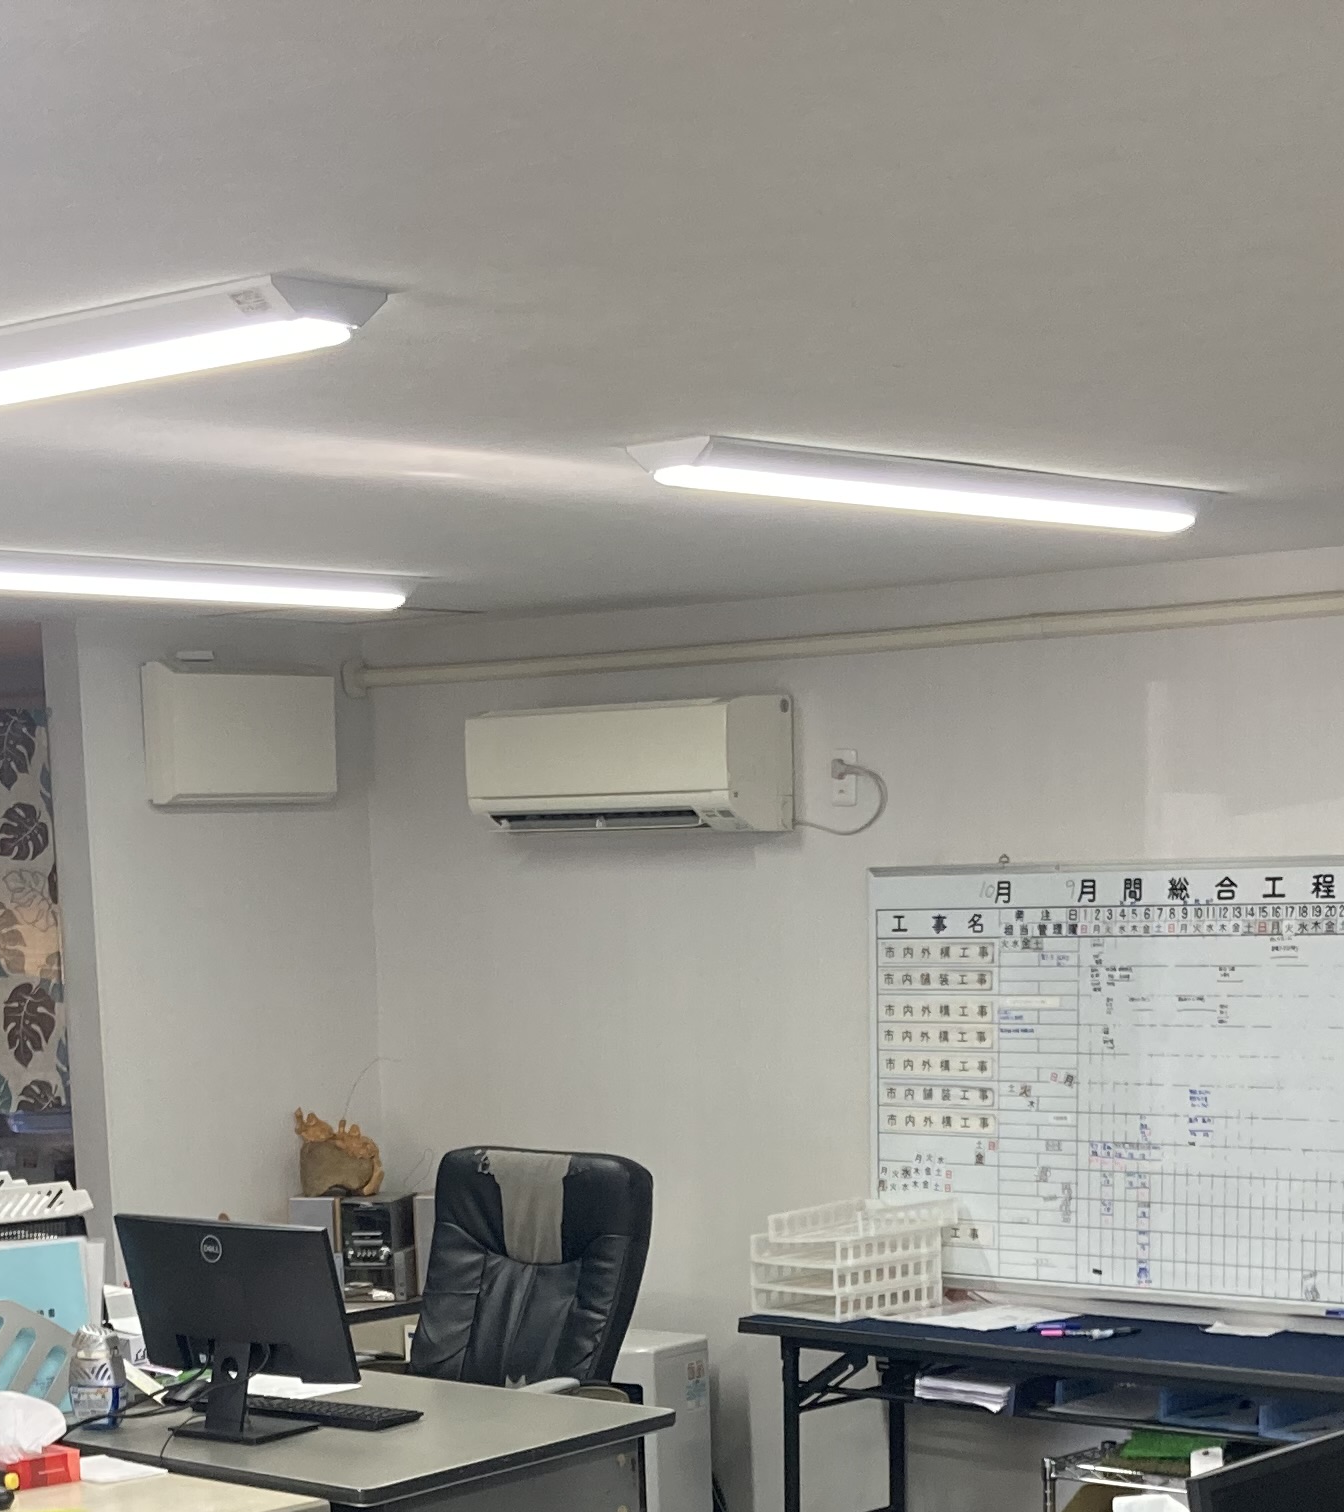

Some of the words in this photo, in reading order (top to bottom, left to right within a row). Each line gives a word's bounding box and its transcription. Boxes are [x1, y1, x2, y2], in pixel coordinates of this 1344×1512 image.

[1068, 908, 1078, 921] 日
[1094, 908, 1100, 921] 2
[1106, 908, 1113, 920] 3
[1119, 908, 1126, 920] 4
[1131, 907, 1138, 920] 5
[1144, 907, 1150, 920] 6
[1156, 907, 1164, 920] 7
[1169, 907, 1176, 920] 8
[1181, 907, 1188, 919] 9
[1194, 907, 1203, 919] 10
[1206, 906, 1216, 919] 11
[1218, 906, 1228, 919] 12
[1232, 906, 1242, 919] 13
[1245, 906, 1254, 919] 14
[1258, 906, 1268, 919] 15
[1272, 906, 1282, 918] 16
[1286, 905, 1294, 918] 17
[1298, 905, 1308, 918] 18
[1312, 905, 1322, 918] 19
[1324, 905, 1336, 918] 20
[892, 913, 984, 934] 工事名
[1168, 923, 1176, 933] 日
[1179, 924, 1188, 934] 月
[1258, 922, 1267, 933] 日
